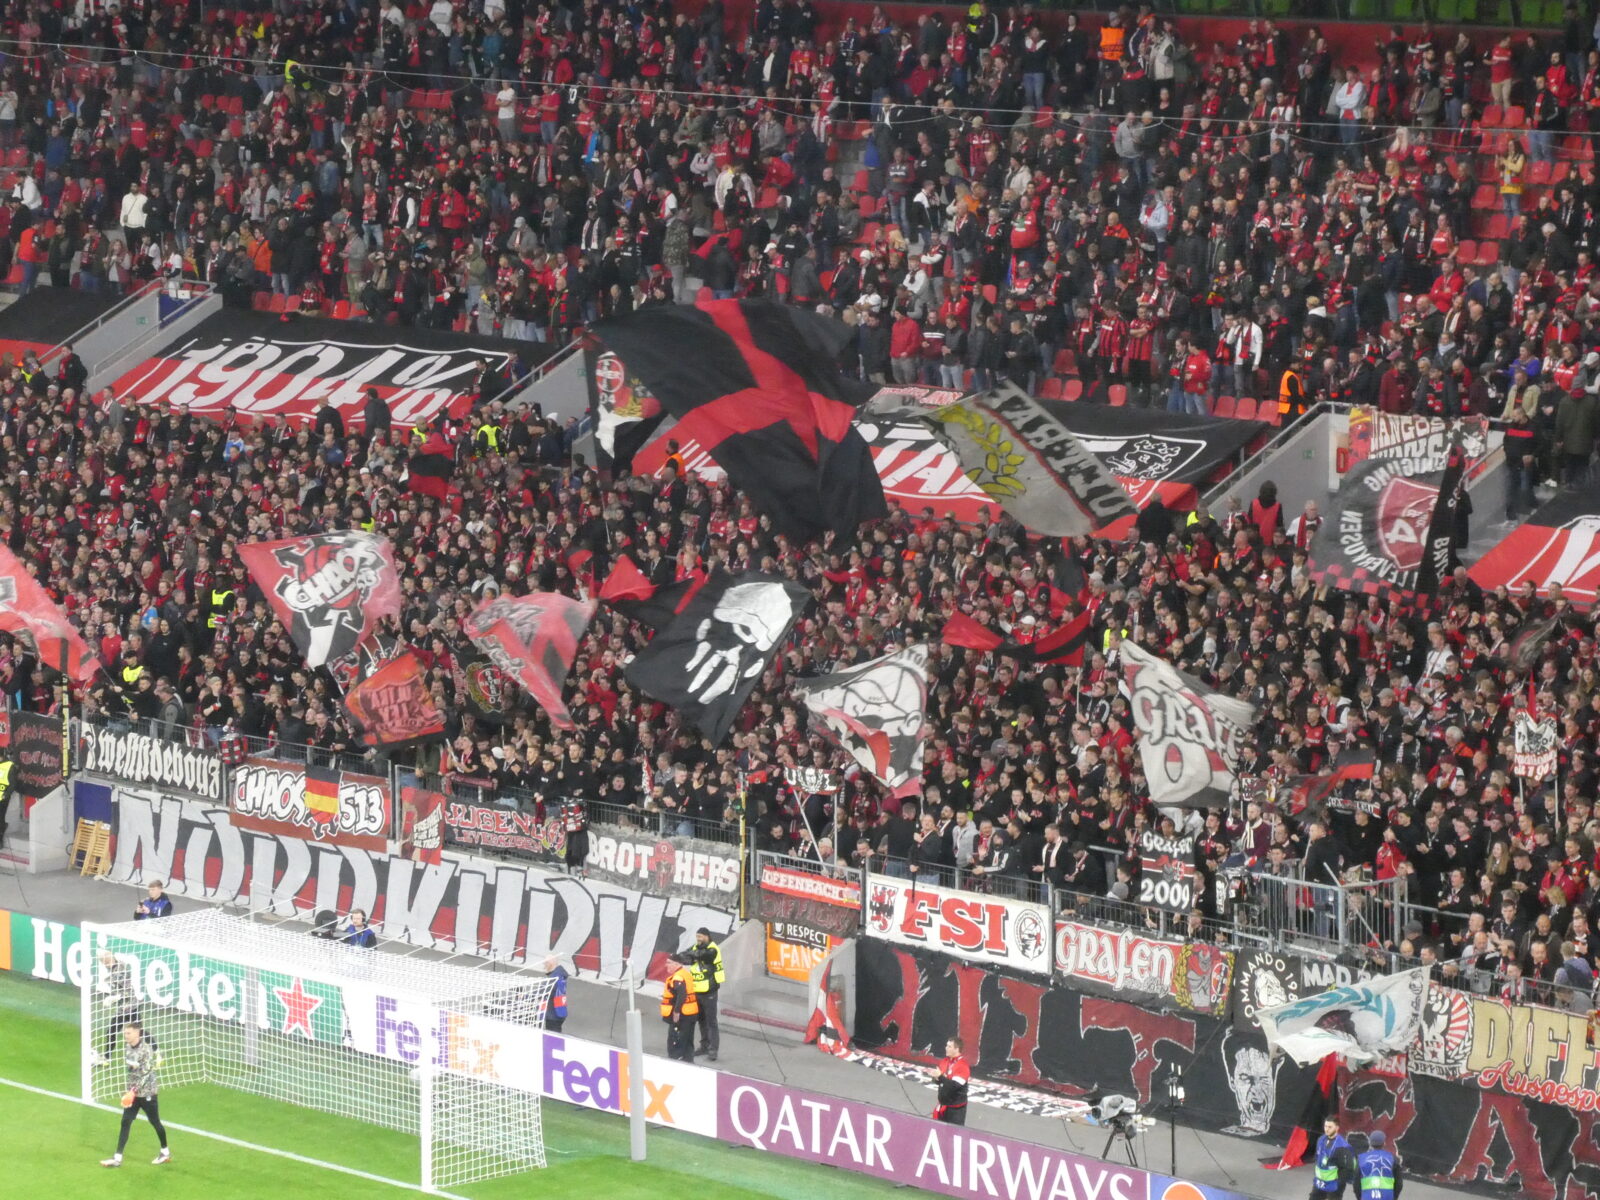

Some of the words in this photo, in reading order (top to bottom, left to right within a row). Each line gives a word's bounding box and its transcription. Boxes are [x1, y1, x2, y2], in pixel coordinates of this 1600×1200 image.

[339, 784, 384, 834] 513
[1140, 877, 1189, 910] 2009
[786, 923, 828, 945] RESPECT
[900, 888, 1008, 955] FSI
[31, 917, 271, 1030] Heneken
[1303, 963, 1352, 988] MAD
[729, 1084, 896, 1172] QATAR
